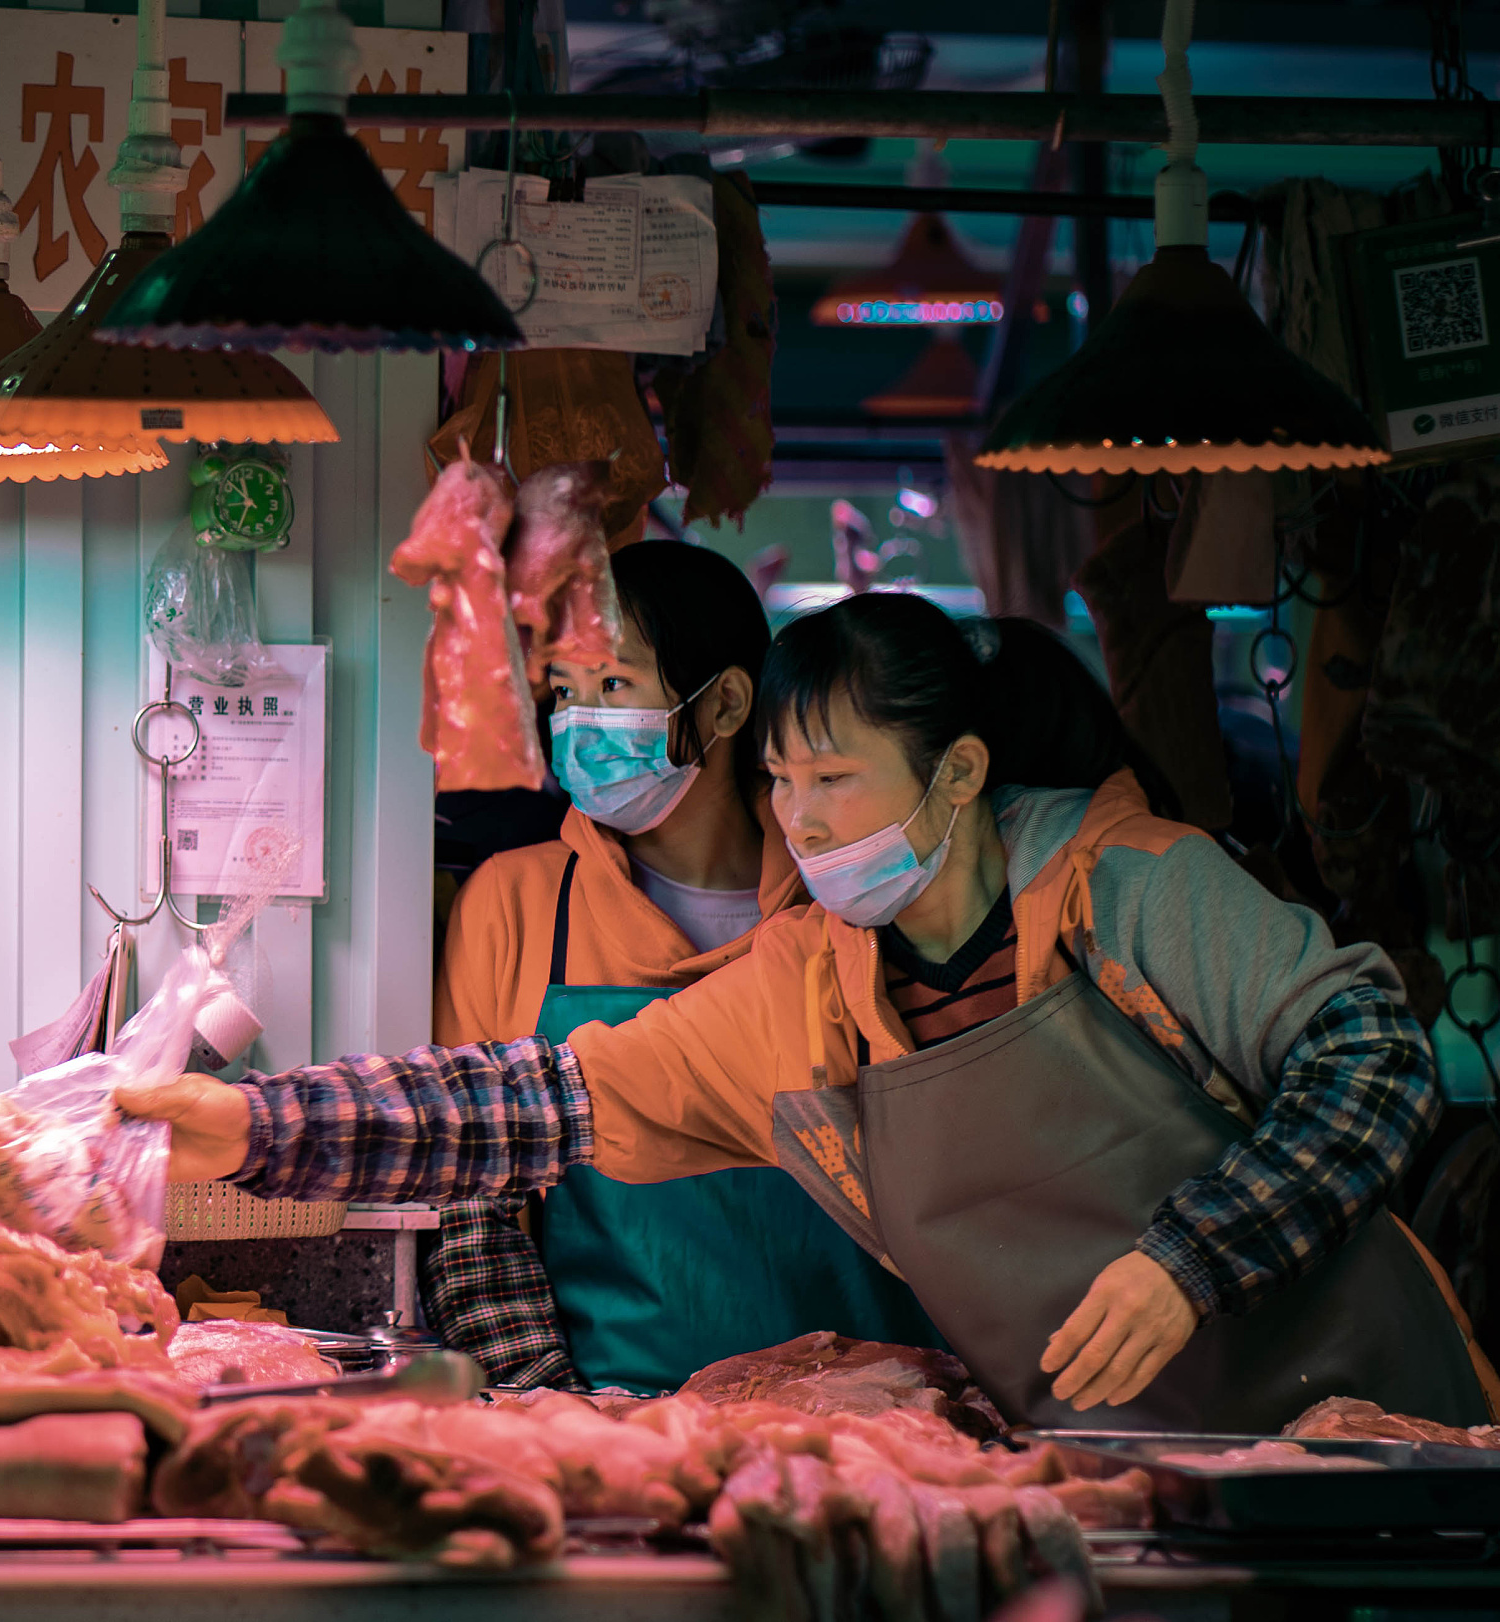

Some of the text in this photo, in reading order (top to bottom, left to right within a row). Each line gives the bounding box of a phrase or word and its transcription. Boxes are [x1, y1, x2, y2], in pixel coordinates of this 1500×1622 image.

[1439, 405, 1498, 428] 微信支付
[240, 467, 253, 479] 12
[265, 484, 274, 495] 2
[269, 499, 278, 511] 3
[264, 514, 274, 525] 4
[255, 523, 264, 533] 5
[189, 696, 279, 716] 营业执照
